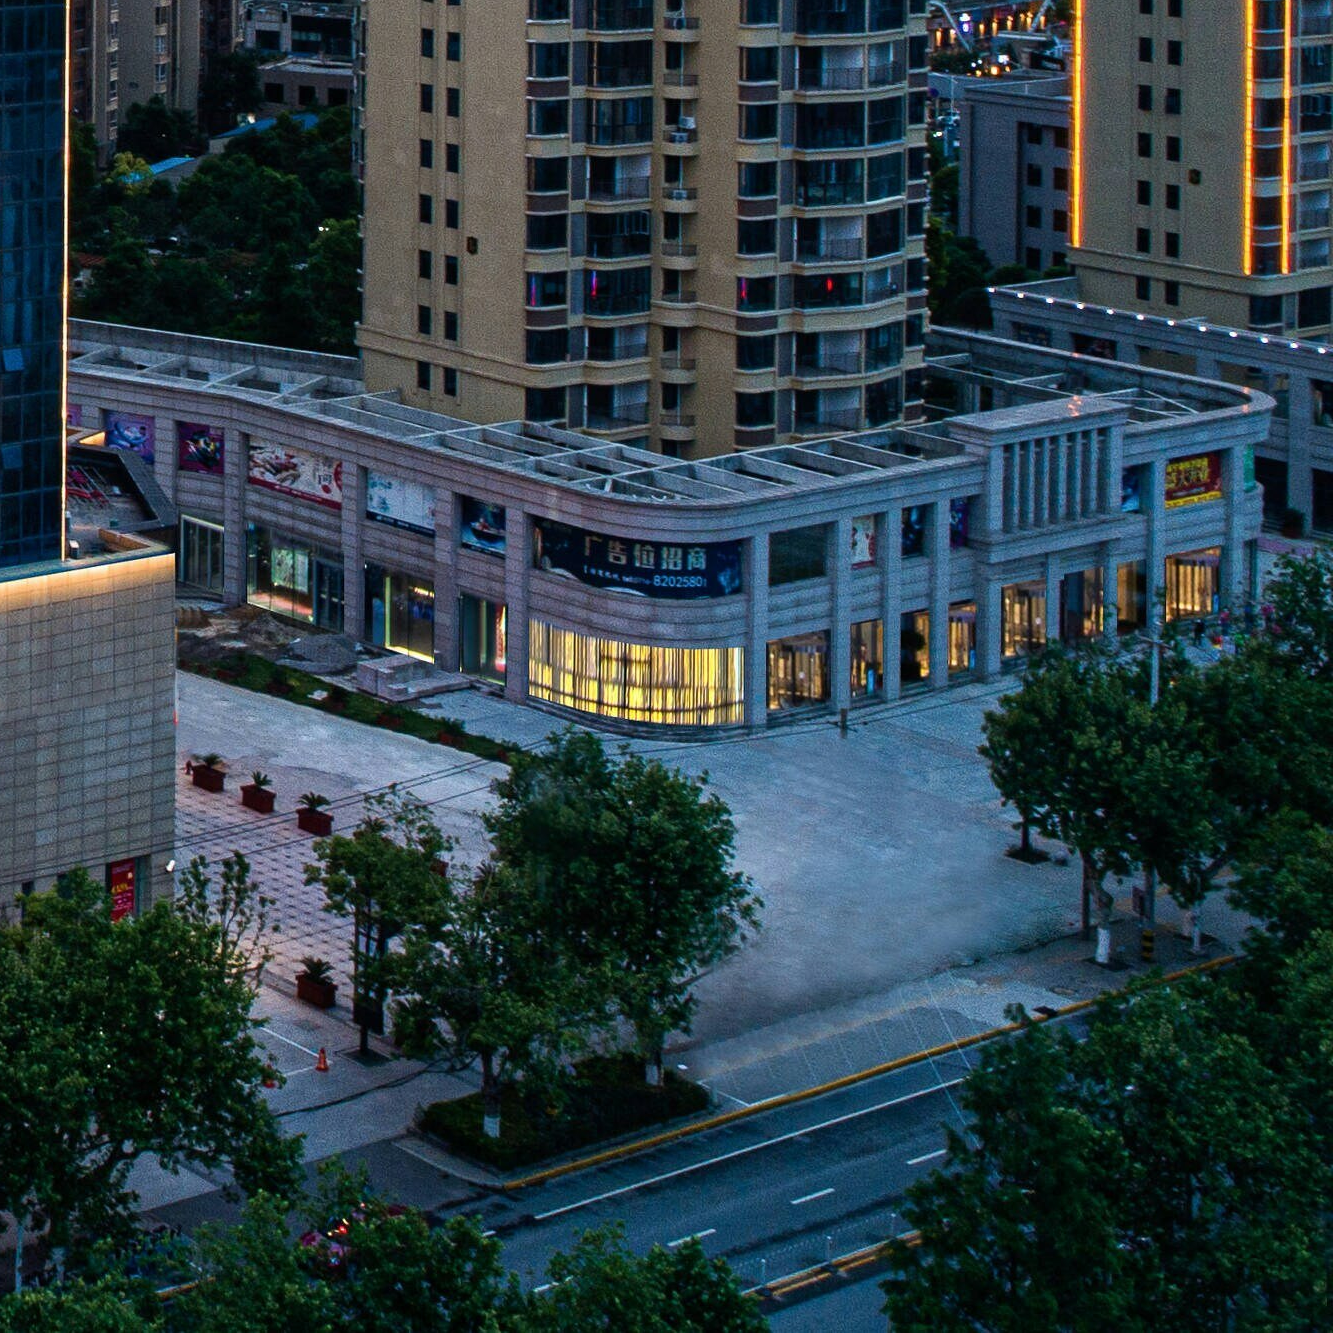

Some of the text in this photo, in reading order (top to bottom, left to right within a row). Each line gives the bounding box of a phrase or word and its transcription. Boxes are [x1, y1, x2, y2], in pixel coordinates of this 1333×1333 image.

[585, 535, 707, 571] 广告位招商
